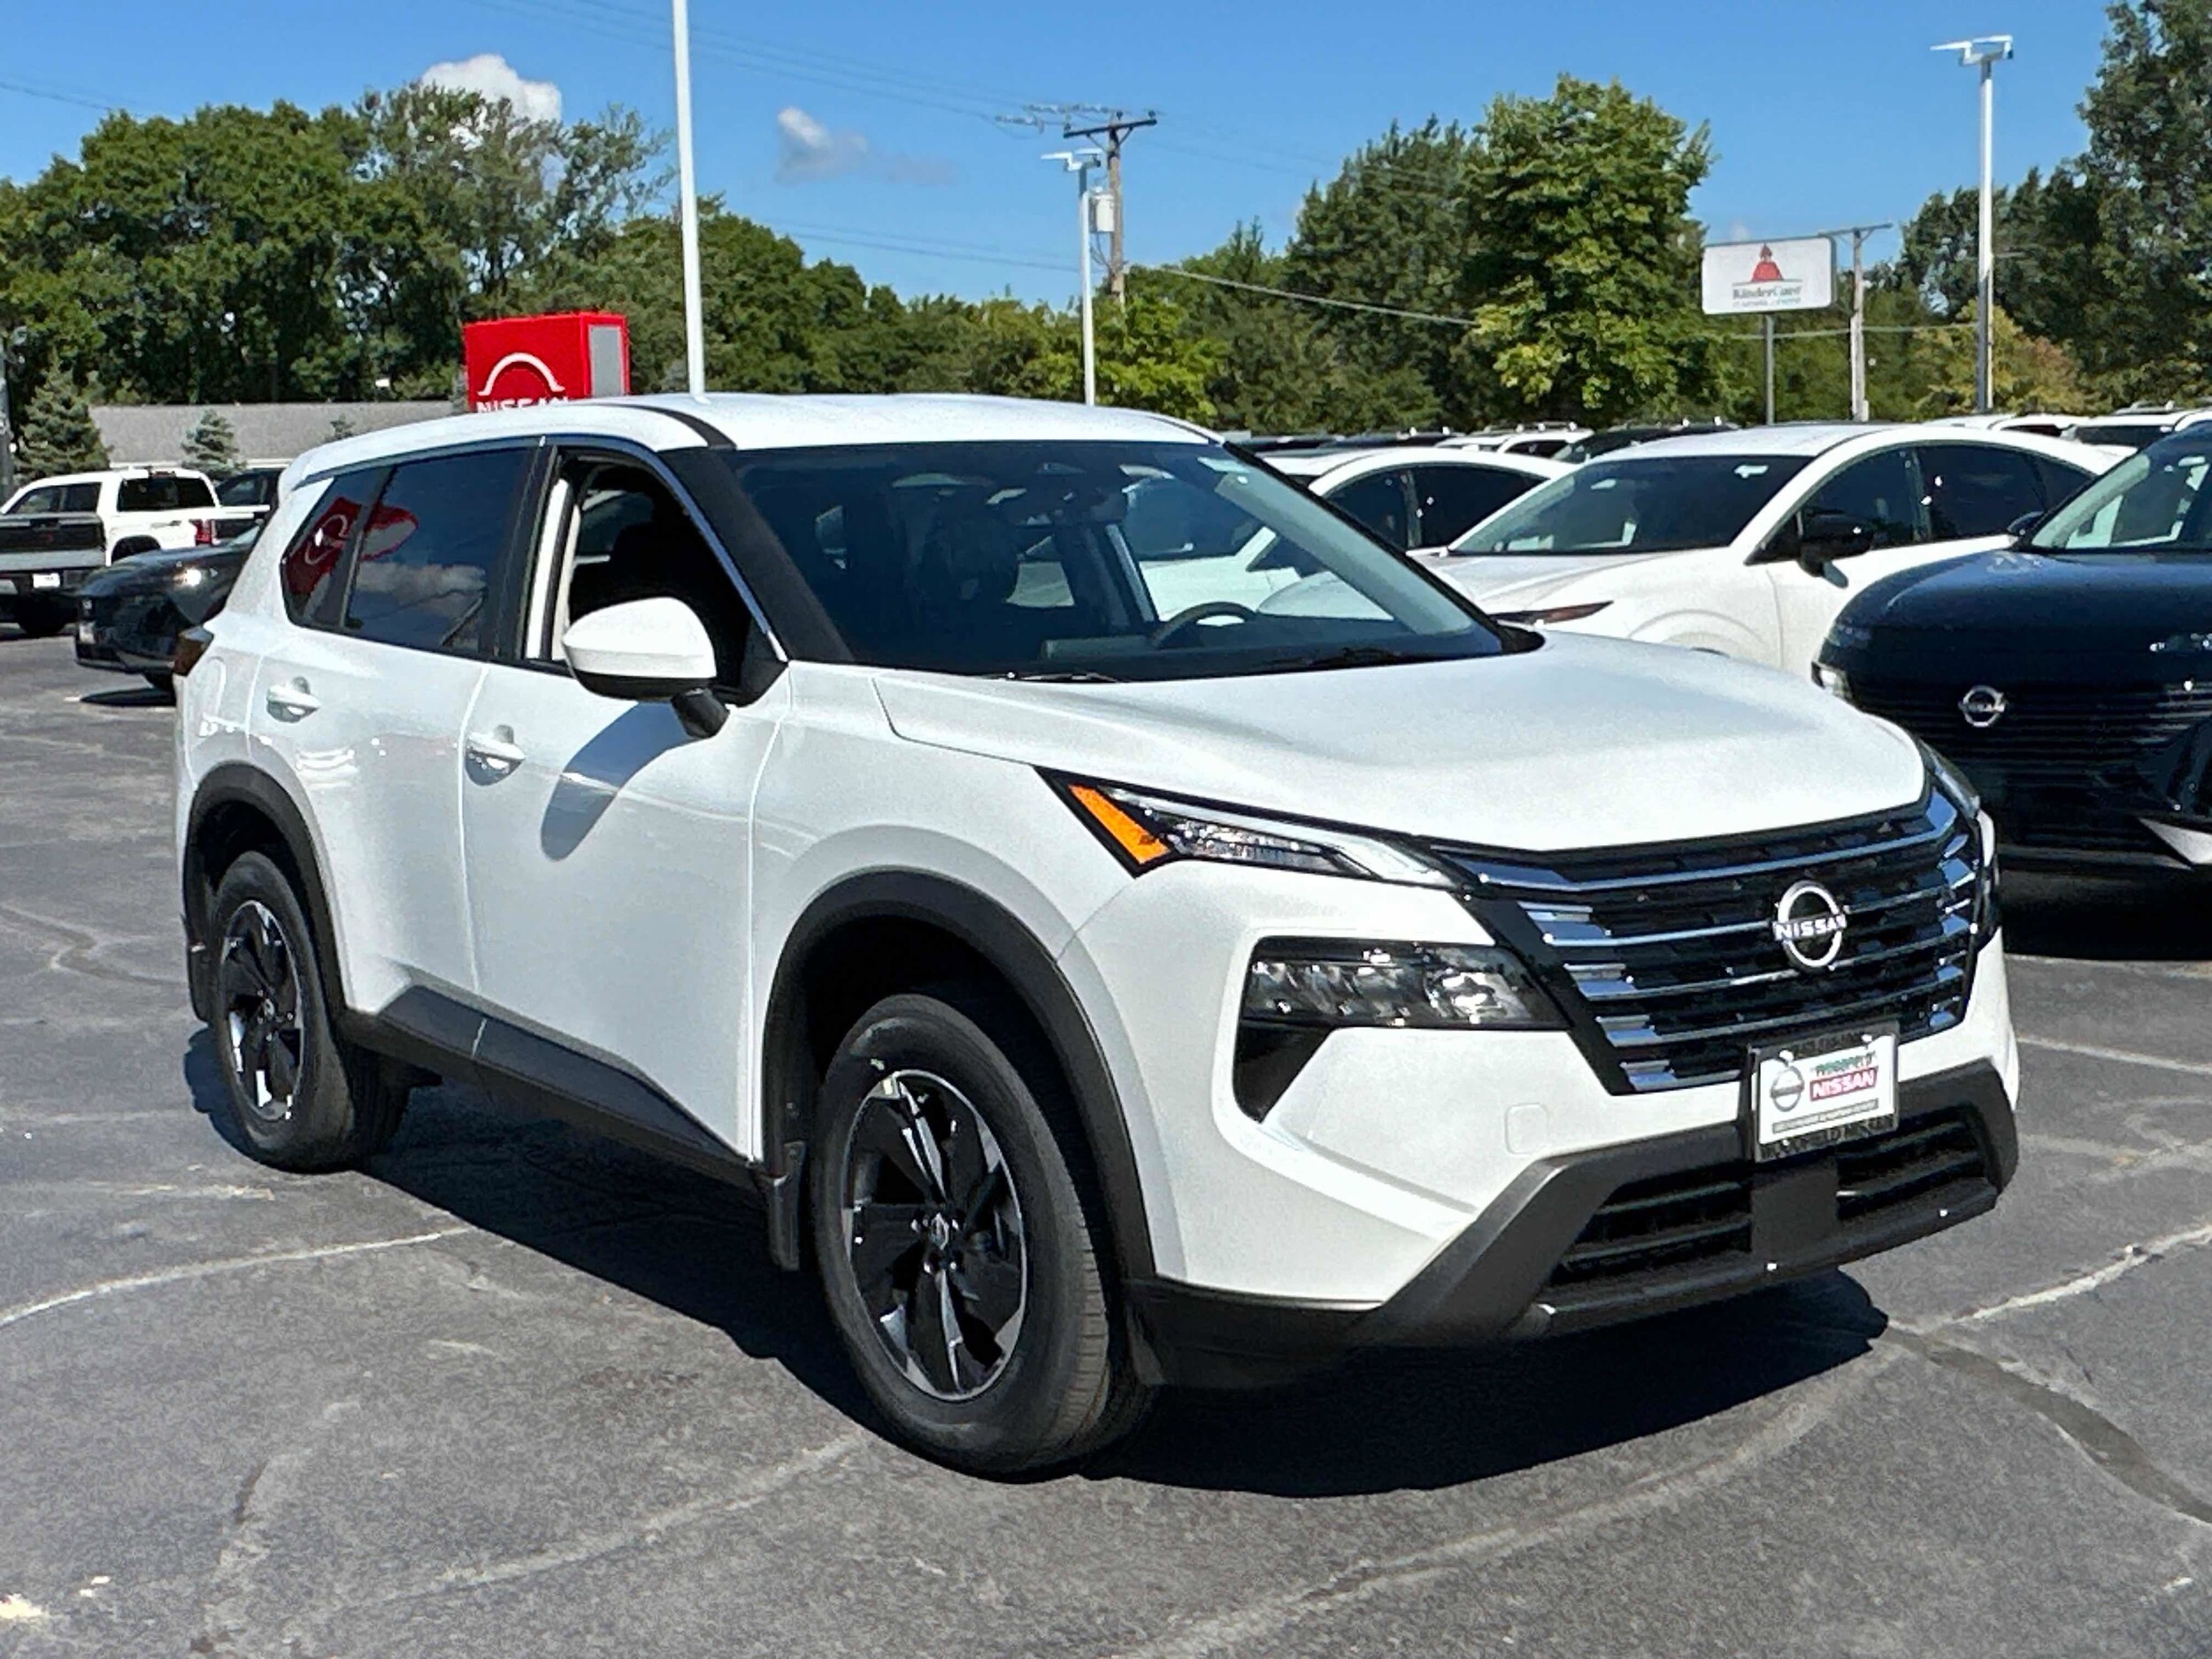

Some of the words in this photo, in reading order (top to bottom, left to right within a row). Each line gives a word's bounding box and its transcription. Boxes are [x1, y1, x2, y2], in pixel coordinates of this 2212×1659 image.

[476, 396, 569, 412] NISS
[1772, 914, 1847, 941] NISSAN
[1812, 1068, 1875, 1099] NISSAN
